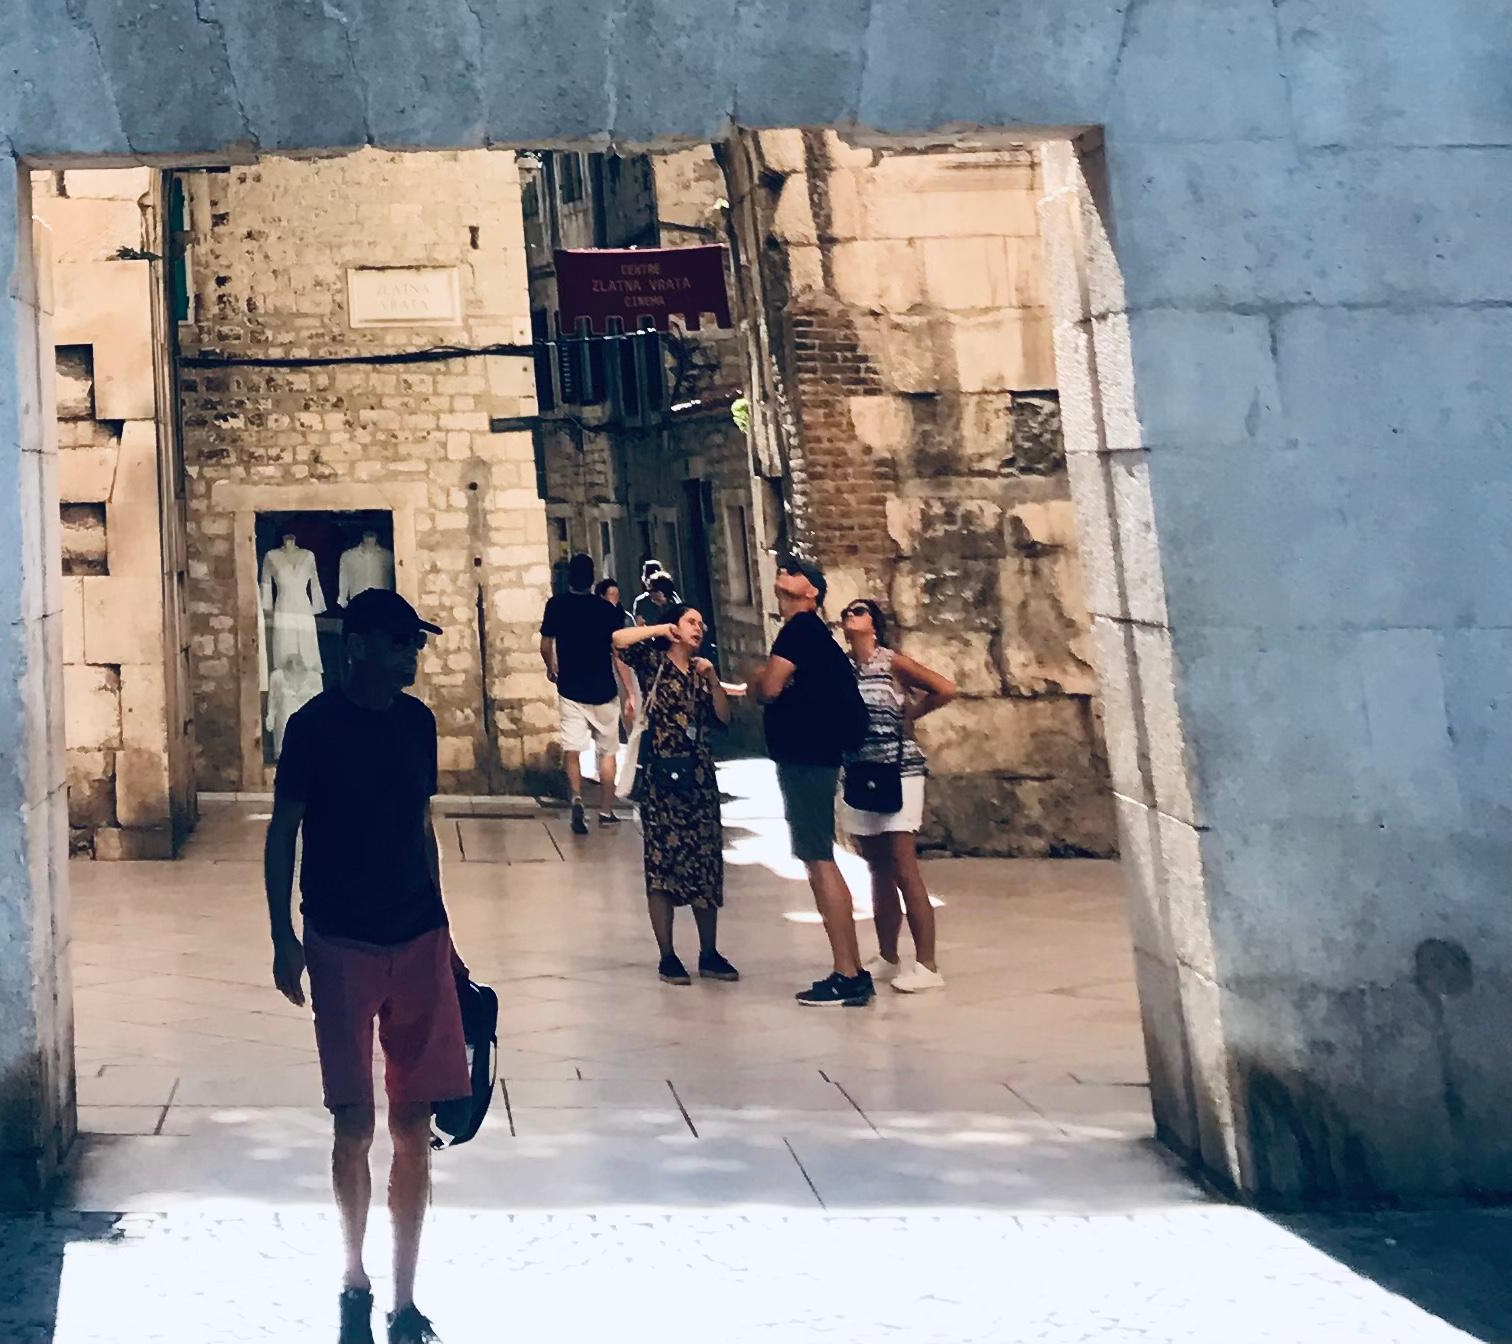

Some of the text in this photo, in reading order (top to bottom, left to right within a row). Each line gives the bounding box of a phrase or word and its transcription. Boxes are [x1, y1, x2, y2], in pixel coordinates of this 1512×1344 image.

[620, 263, 660, 275] CENTRE
[591, 276, 692, 292] ZLATNA VRATA
[624, 295, 665, 307] CINEMA
